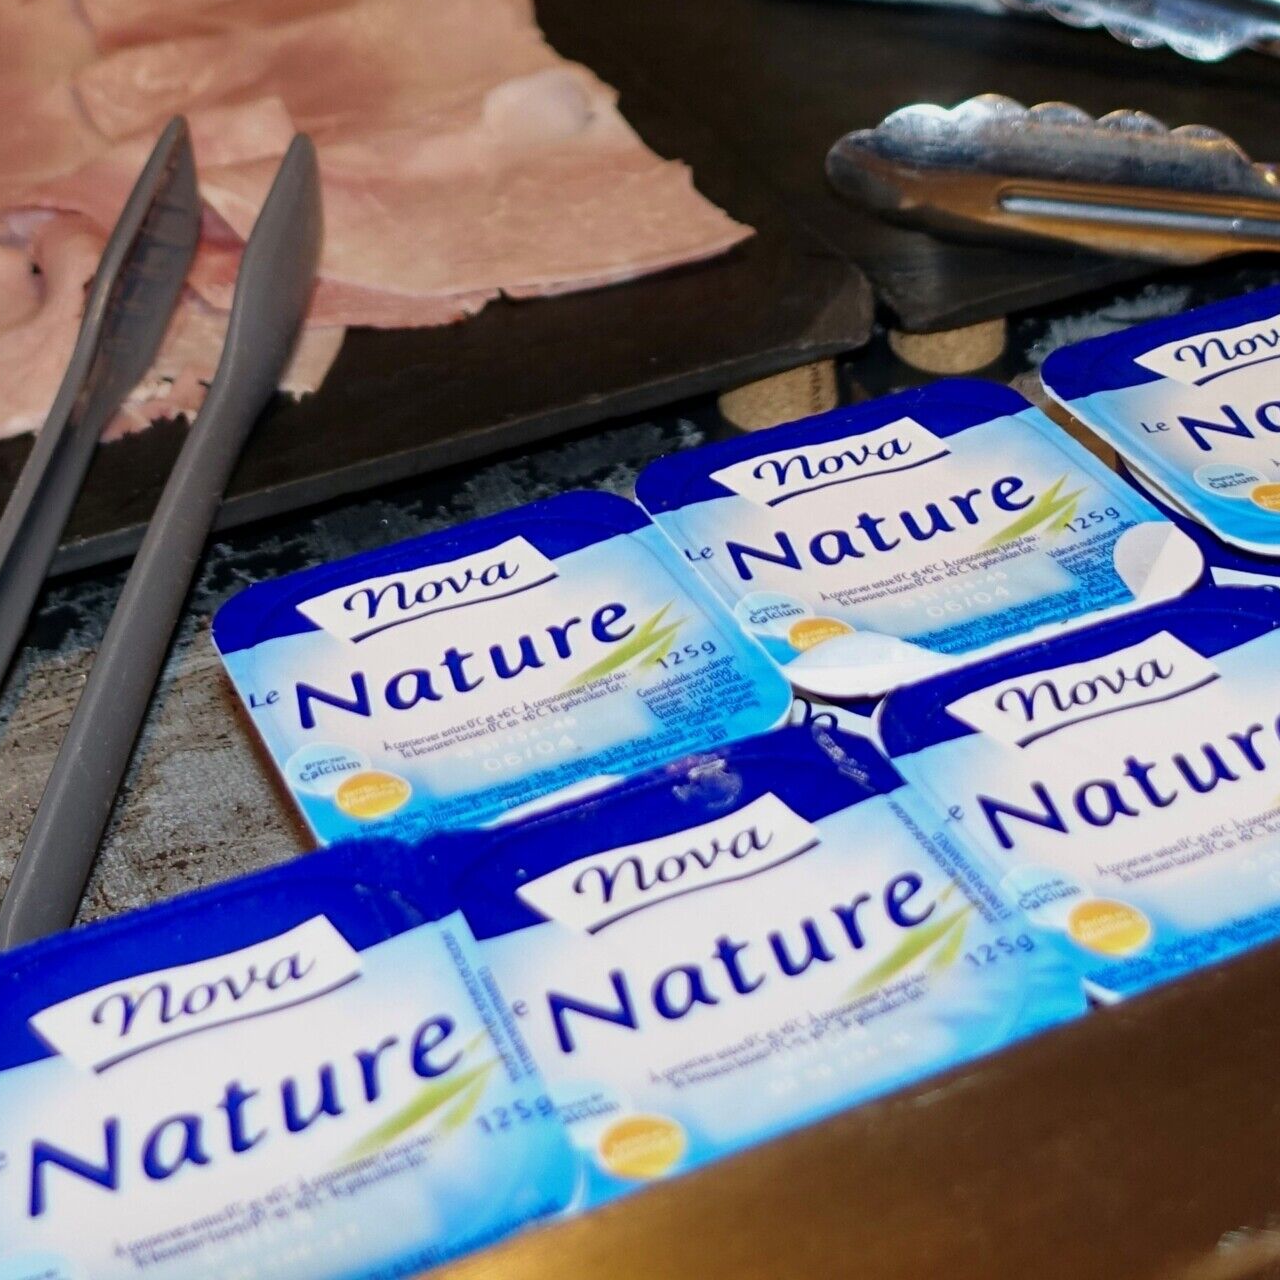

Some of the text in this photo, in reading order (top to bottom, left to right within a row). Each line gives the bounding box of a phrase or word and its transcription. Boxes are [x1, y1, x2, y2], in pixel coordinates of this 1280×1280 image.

[1140, 417, 1171, 435] Le
[753, 432, 912, 487] Nova
[1209, 476, 1259, 489] Calcium
[685, 472, 1037, 581] Le Nature
[1063, 505, 1120, 533] 125g
[343, 559, 520, 620] Nova
[749, 607, 805, 624] Calcium
[249, 601, 636, 730] Le Nature
[655, 638, 717, 670] 125g
[994, 658, 1172, 720] Nova
[299, 761, 362, 781] Calcium
[573, 824, 774, 903] Nova
[1018, 885, 1081, 910] Calcium
[545, 869, 940, 1054] Nature
[964, 932, 1036, 969] 125g
[91, 949, 315, 1039] Nova
[27, 1014, 464, 1218] Nature
[477, 1094, 554, 1134] 125g
